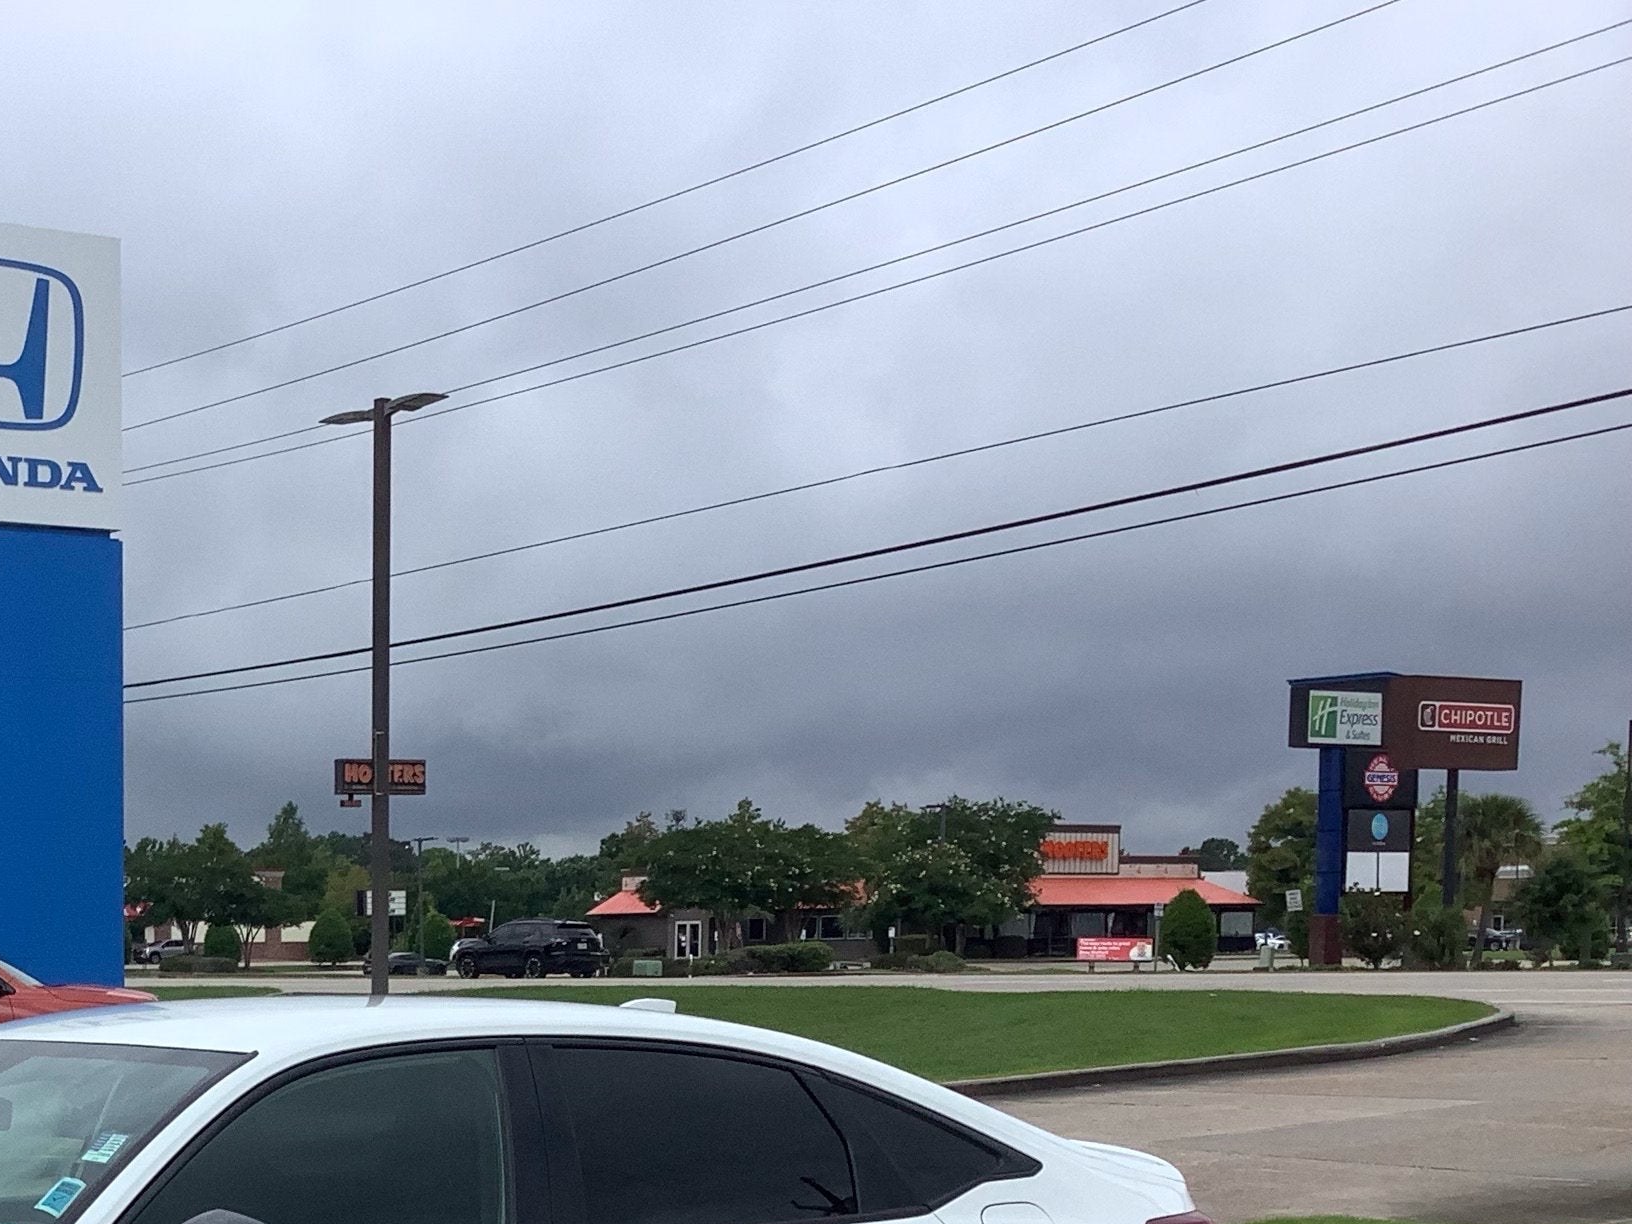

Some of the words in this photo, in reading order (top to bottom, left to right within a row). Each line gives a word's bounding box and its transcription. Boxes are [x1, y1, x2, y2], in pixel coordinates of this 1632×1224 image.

[1339, 709, 1378, 728] Express
[1440, 709, 1510, 727] CHIPOTLE
[1449, 734, 1485, 744] MEXICAN
[1486, 735, 1508, 745] GRILL
